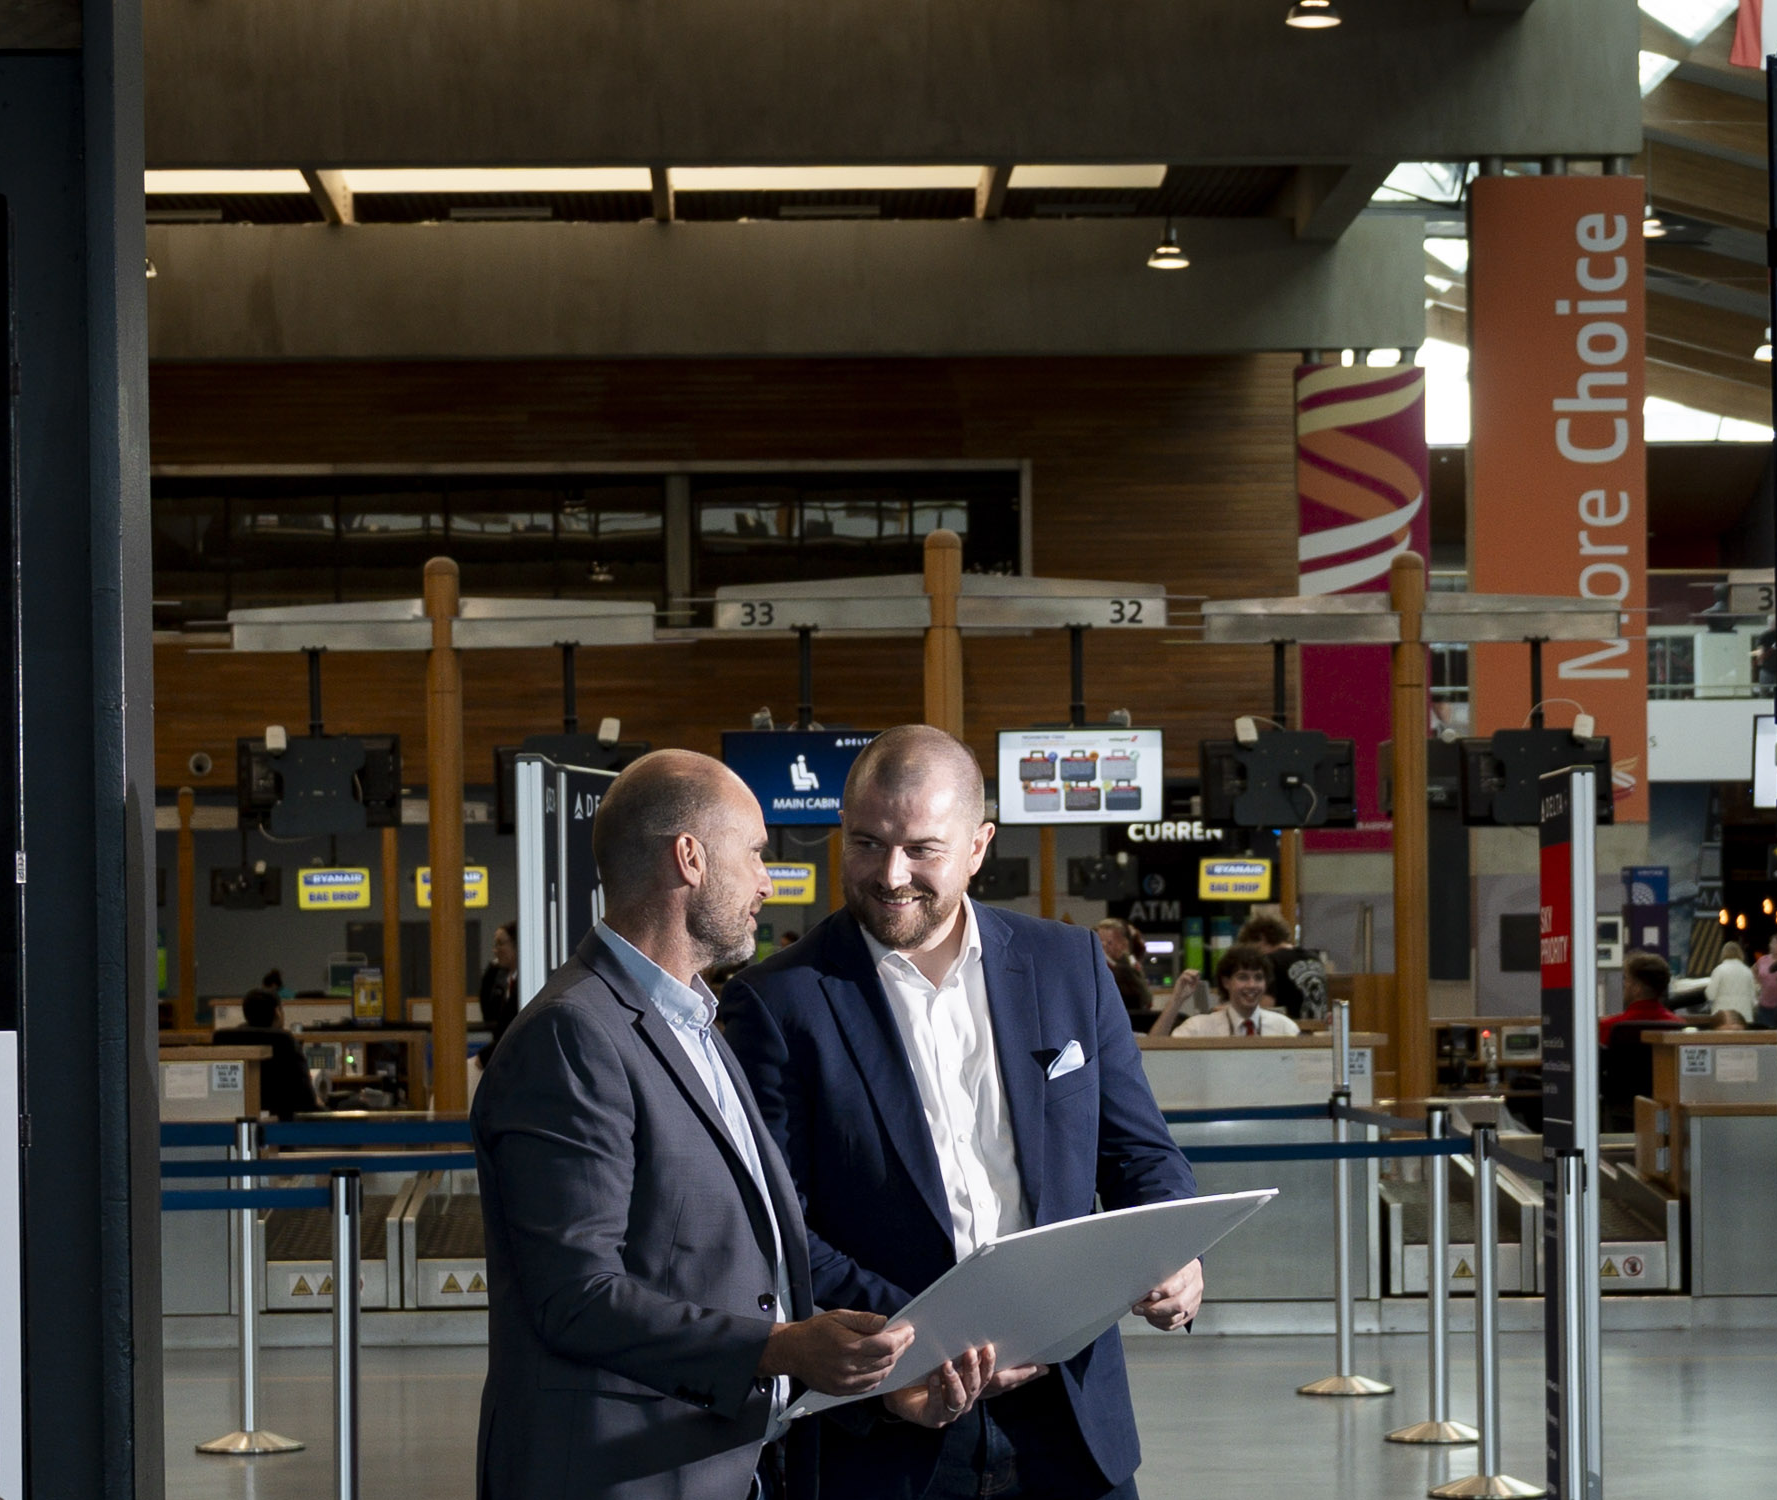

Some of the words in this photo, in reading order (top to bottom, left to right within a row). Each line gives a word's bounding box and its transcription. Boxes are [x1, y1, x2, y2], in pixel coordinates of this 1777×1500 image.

[1553, 212, 1628, 464] Choice
[1557, 490, 1630, 680] More
[740, 602, 774, 627] 33
[1109, 599, 1144, 624] 32
[772, 798, 805, 810] MAIN
[805, 798, 840, 810] CABIN
[312, 874, 363, 883] RYANAIR
[1213, 865, 1265, 874] RYANAIR
[1128, 900, 1181, 922] ATM
